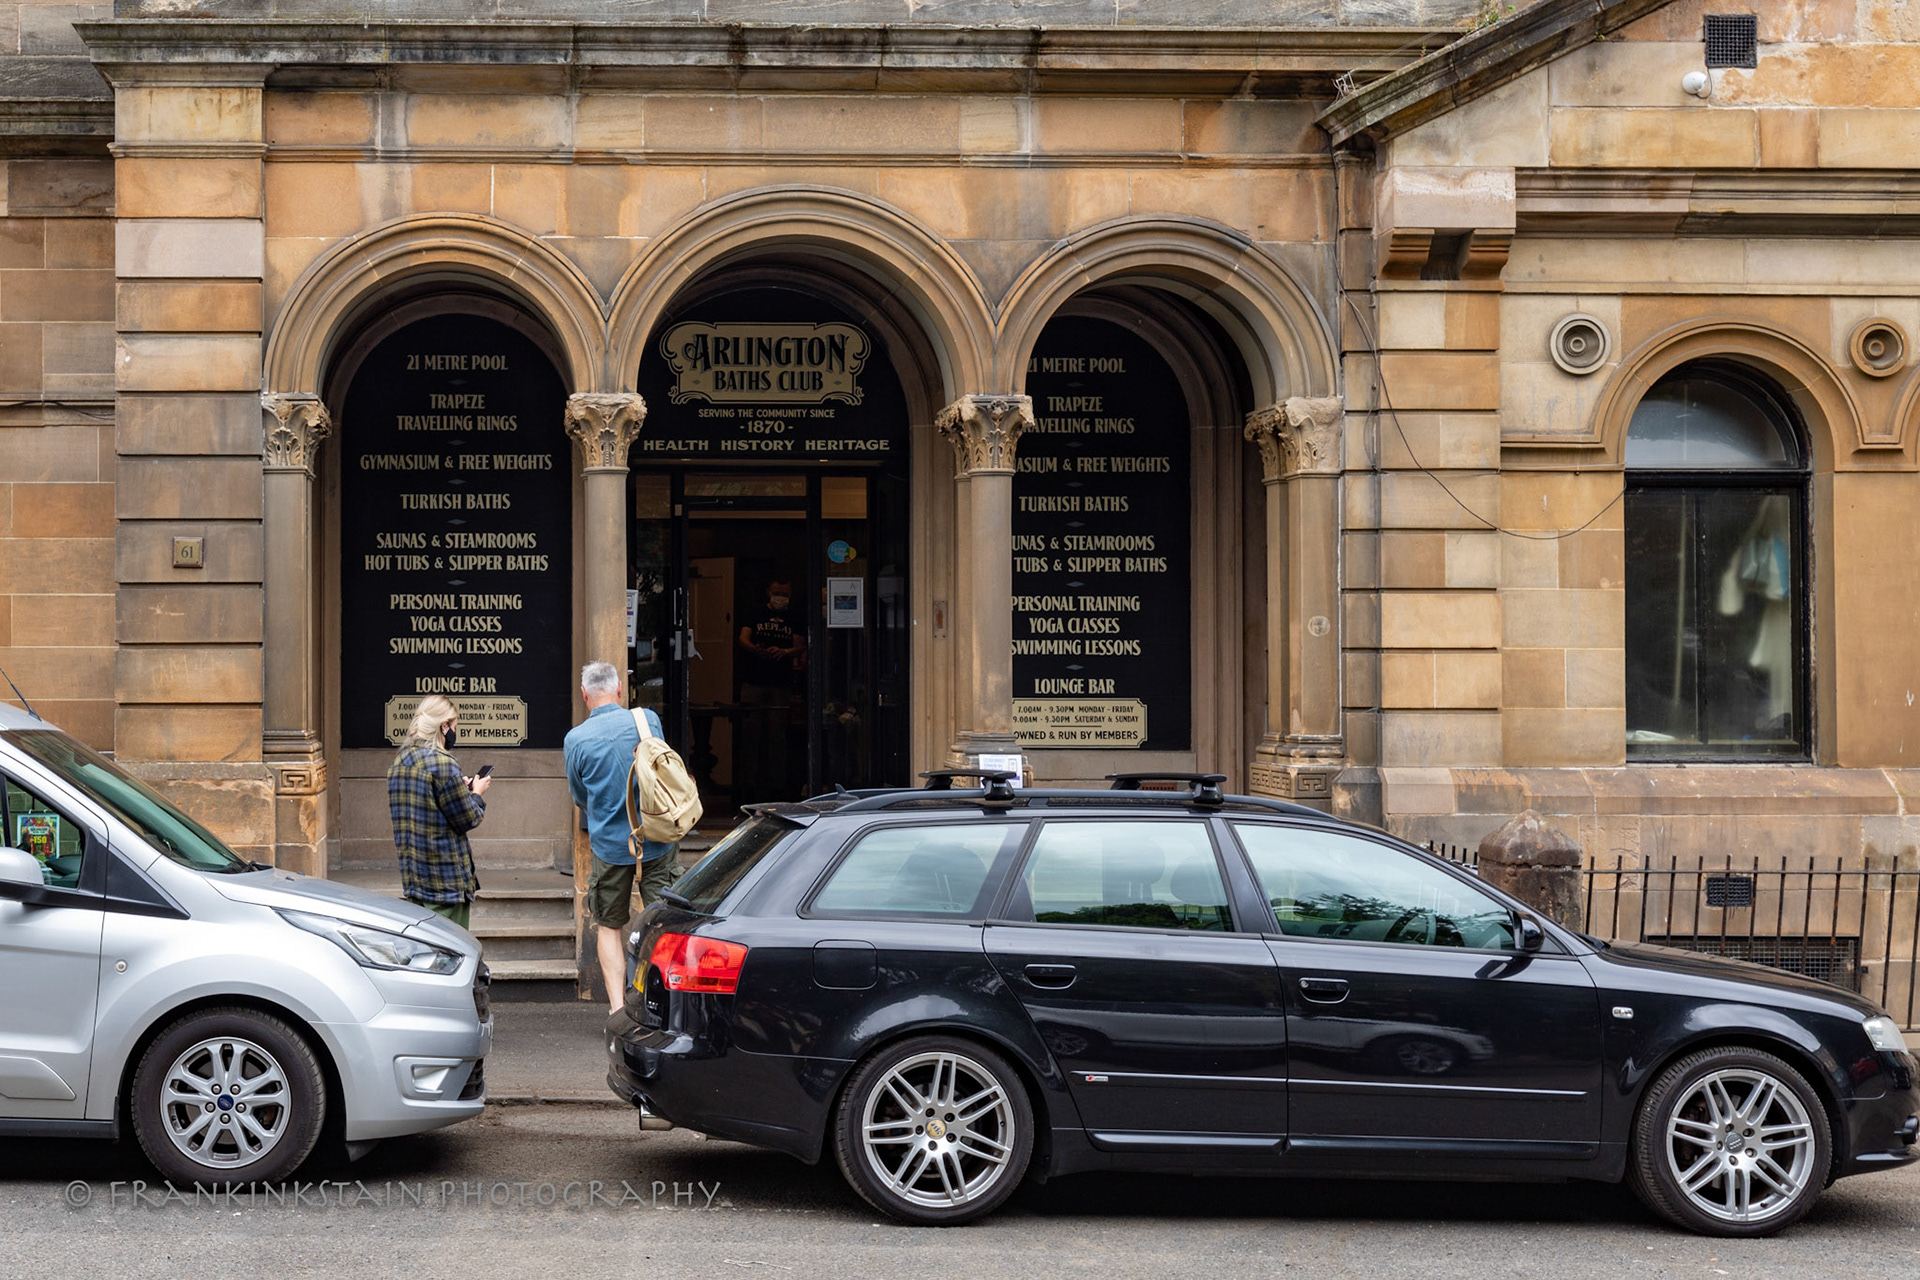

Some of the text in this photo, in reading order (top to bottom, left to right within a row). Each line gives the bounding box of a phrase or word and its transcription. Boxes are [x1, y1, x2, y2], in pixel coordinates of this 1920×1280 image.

[682, 333, 849, 373] ARLINGTON
[406, 355, 508, 370] 21 METRE POOL
[1042, 358, 1086, 372] METRE
[1089, 358, 1126, 372] POOL
[712, 370, 824, 391] BATHS CLUB
[429, 394, 486, 409] TRAPEZE
[1047, 396, 1103, 412] TRAPEZE
[698, 409, 835, 418] SERVING THE COMMUNITY SINCE
[397, 416, 517, 430] TRAVELLING RINGS
[1023, 418, 1135, 433] AVELLING RINGS
[643, 440, 890, 450] HEALTH HISTORY HERITAGE
[360, 454, 553, 470] GYMNASIUM & FREE WEIGHTS
[1015, 457, 1170, 473] ASIUM & FREE WEIGHTS
[400, 494, 511, 510] TURKISH BATHS
[1019, 496, 1129, 512] TURKISH BATHS
[376, 533, 537, 548] SAUNAS & STEAMROOMS
[1012, 535, 1155, 550] UNAS & STEAMROOMS
[181, 546, 193, 558] 61
[364, 555, 549, 571] HOT TUBS & SLIPPER BATHS
[1014, 557, 1167, 572] TUBS & SLIPPER BATHS
[390, 594, 523, 610] PERSONAL TRAINING
[1011, 596, 1141, 612] PERSONAL TRAINING
[410, 616, 502, 632] YOGA CLASSES
[1029, 618, 1121, 633] YOGA CLASSES
[389, 638, 523, 654] SWIMMING LESSONS
[1011, 640, 1141, 656] SWIMMING LESSONS
[416, 677, 497, 693] LOUNGE BAR
[1034, 678, 1115, 694] LOUNGE BAR
[460, 729, 518, 738] BY MEMBERS
[1013, 731, 1138, 740] OWNED & RUN BY MEMBERS
